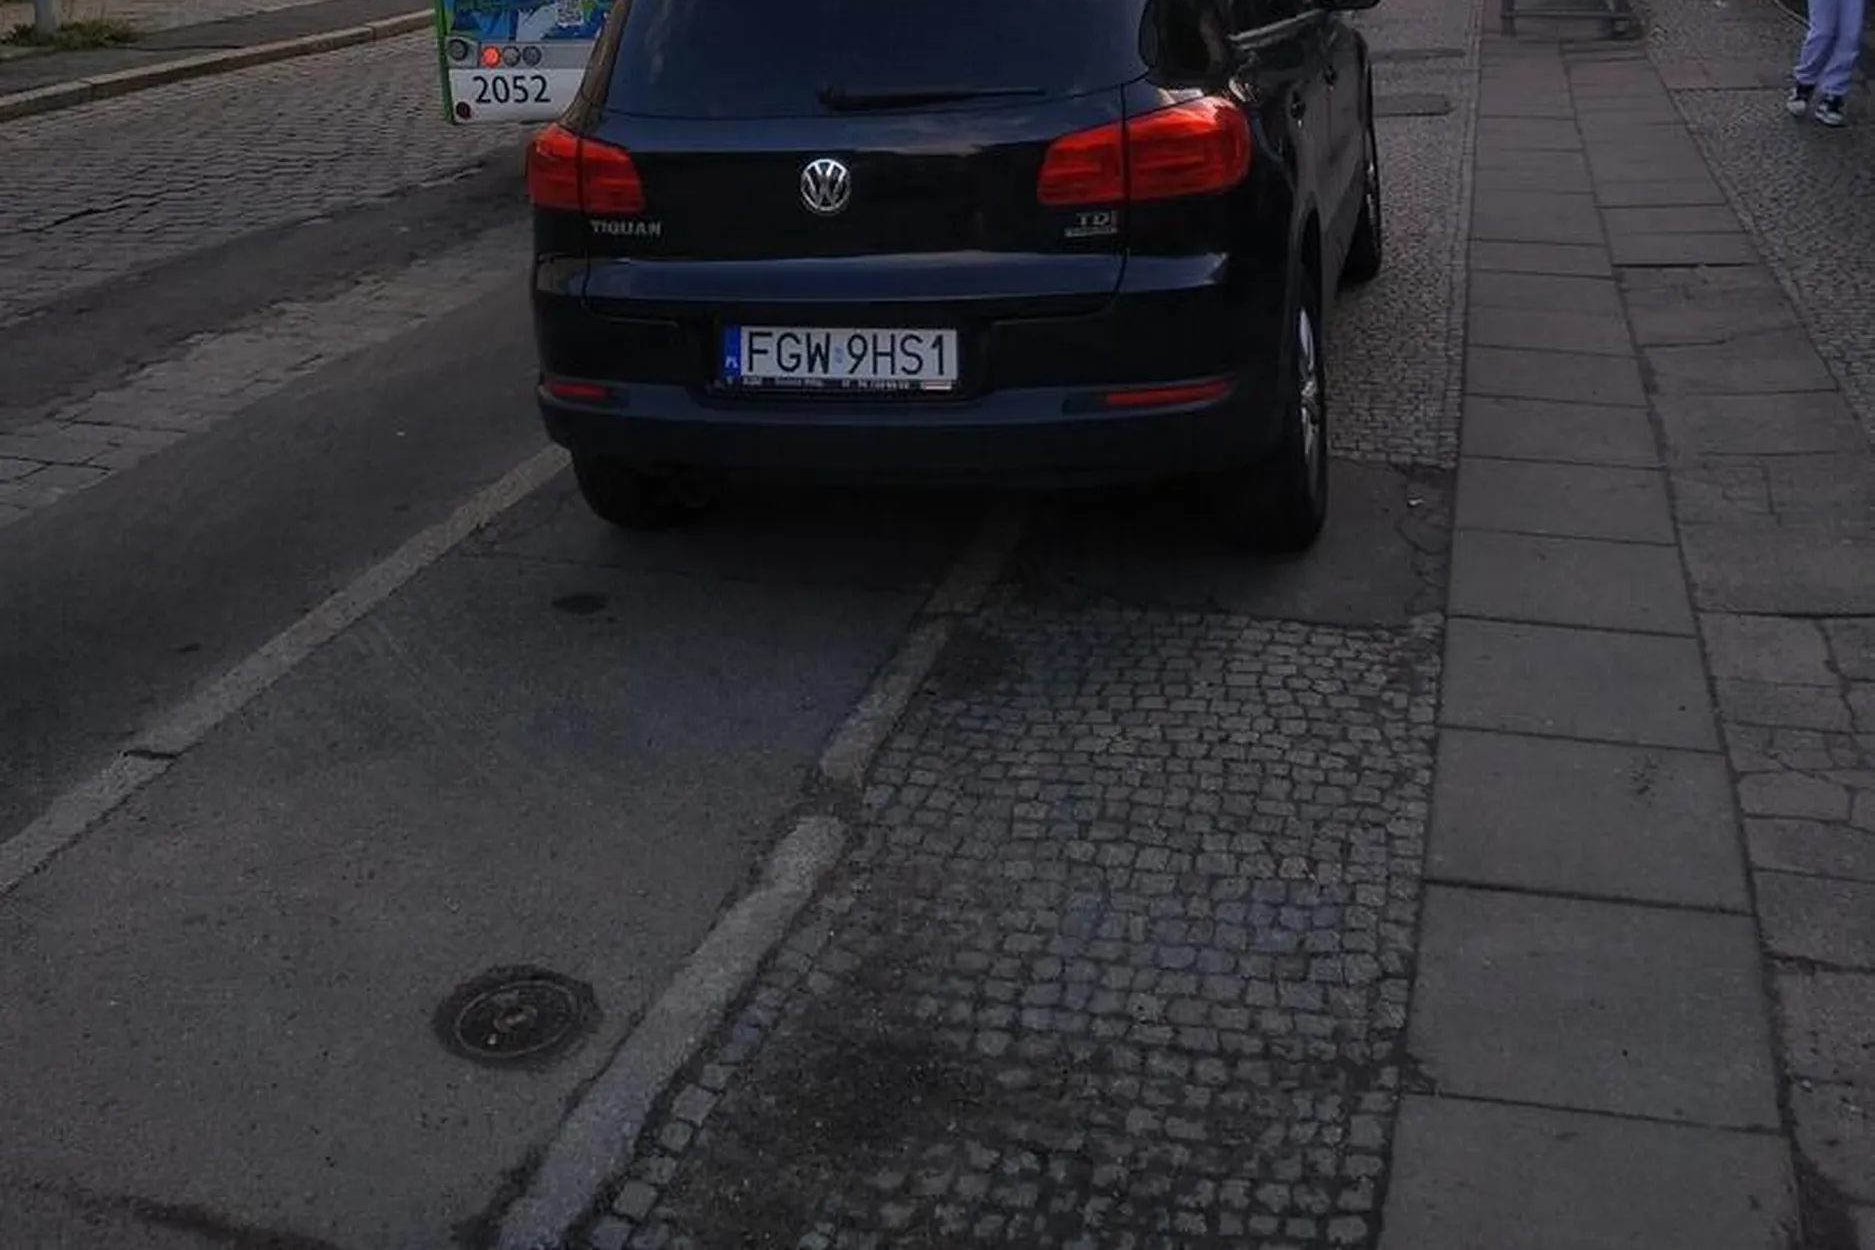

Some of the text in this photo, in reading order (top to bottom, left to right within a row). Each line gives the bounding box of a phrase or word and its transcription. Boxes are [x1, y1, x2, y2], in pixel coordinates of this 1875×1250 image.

[472, 74, 551, 104] 2052
[590, 219, 662, 238] TIGUAN
[1075, 210, 1118, 226] TDI
[748, 331, 946, 377] FGW 9HS1
